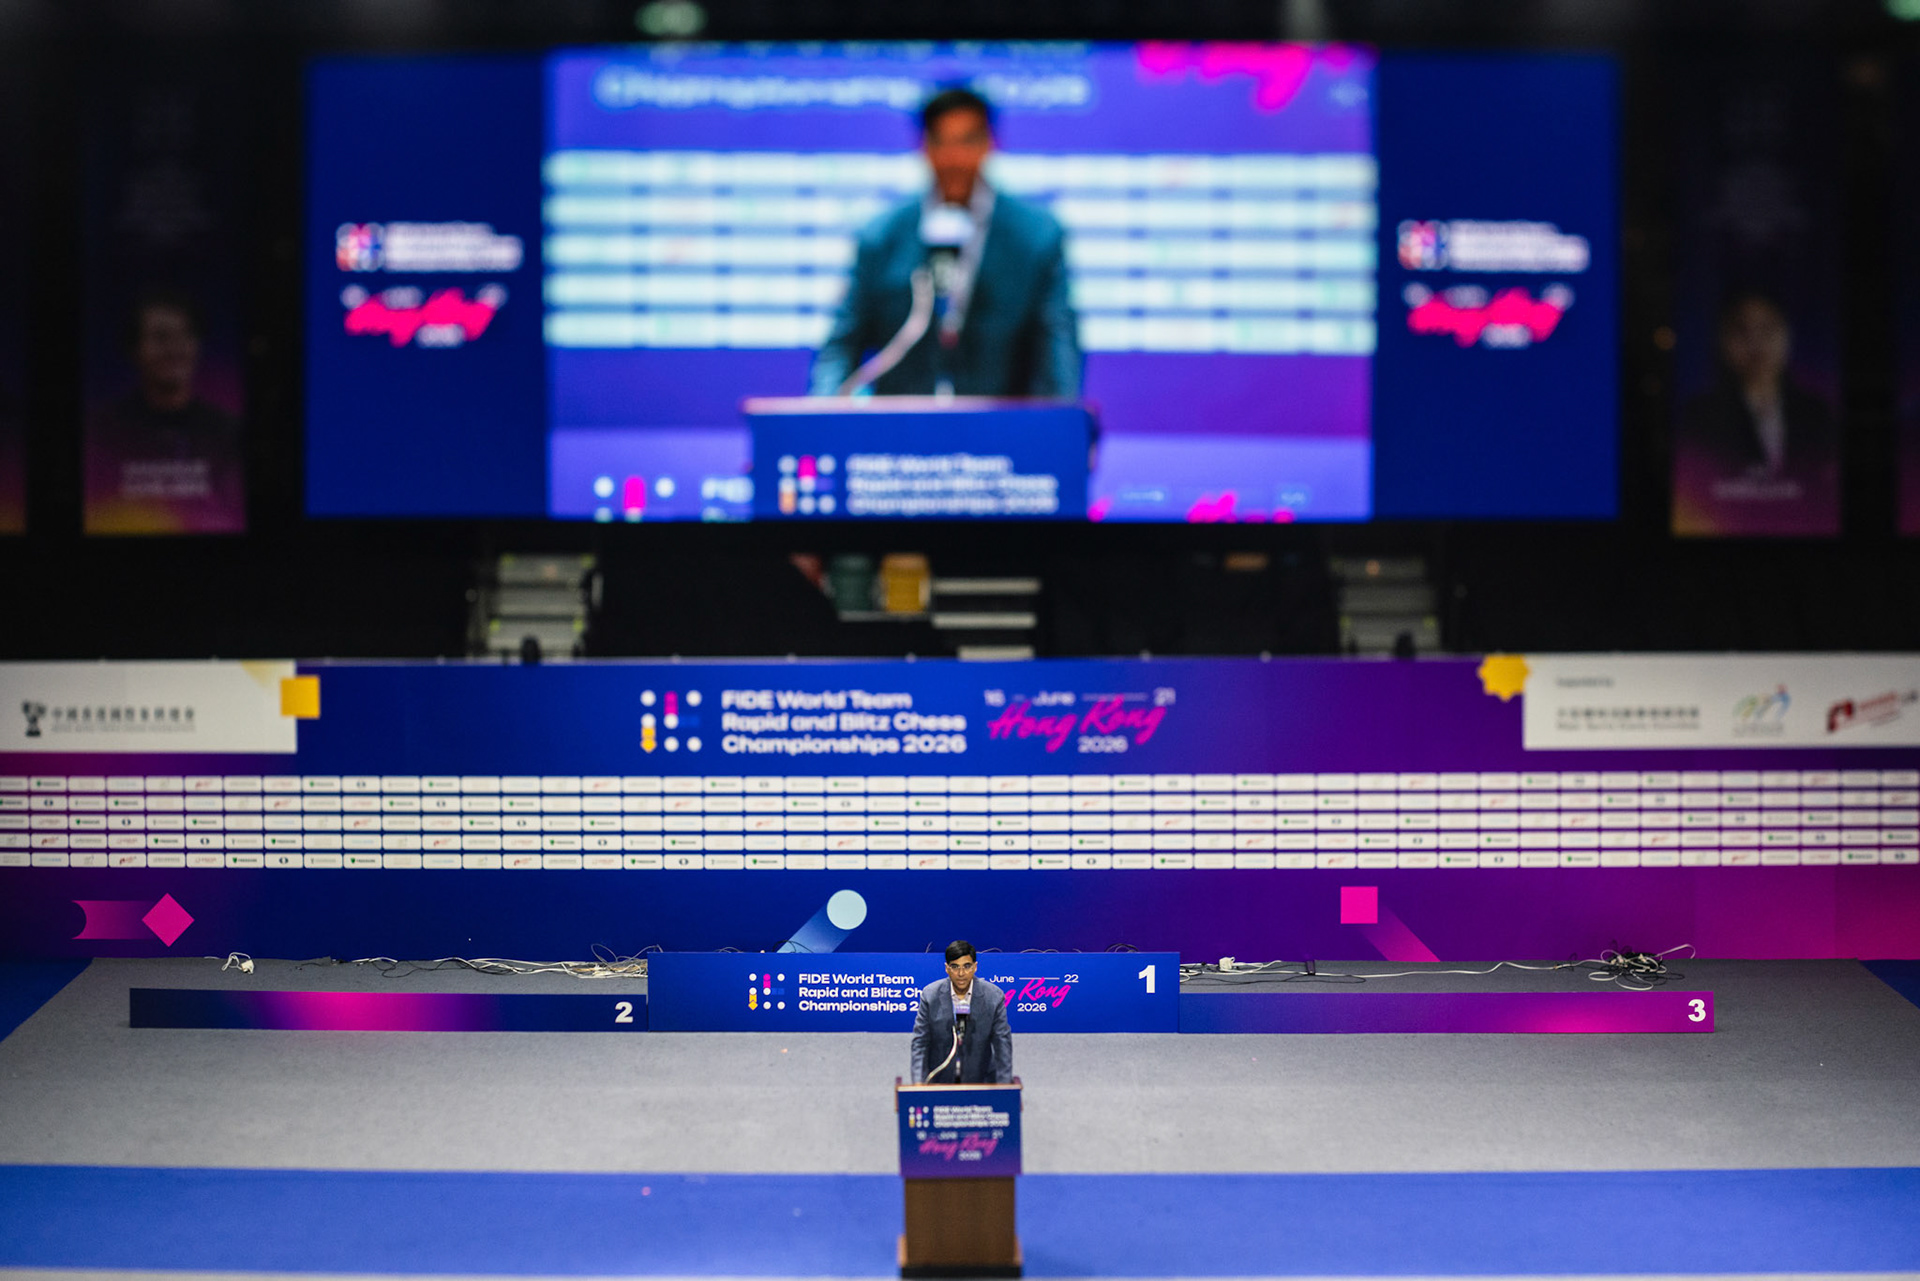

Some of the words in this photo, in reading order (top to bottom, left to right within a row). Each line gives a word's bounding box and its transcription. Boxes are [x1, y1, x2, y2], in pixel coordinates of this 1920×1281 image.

[721, 689, 774, 710] FIDE
[775, 689, 847, 710] World
[847, 689, 913, 710] Team
[1032, 690, 1076, 707] June
[721, 712, 789, 734] Rapid
[790, 713, 838, 732] and
[839, 712, 891, 732] Blitz
[892, 711, 967, 732] Chess
[987, 699, 1078, 753] Hong
[1079, 693, 1168, 746] Kong
[721, 734, 901, 756] Championships
[902, 734, 967, 754] 2026
[1078, 735, 1129, 753] 2026
[799, 973, 830, 984] FIDE
[832, 973, 874, 984] World
[876, 973, 915, 984] Team
[989, 974, 1015, 983] June
[1064, 974, 1079, 983] 22
[1138, 964, 1156, 994] 1
[799, 986, 838, 999] Rapid
[840, 987, 869, 998] and
[871, 986, 902, 998] Blitz
[903, 987, 923, 998] Ch
[1018, 976, 1072, 1008] Kong
[614, 1001, 634, 1023] 2
[798, 1000, 907, 1013] Championships
[909, 1000, 919, 1012] 2
[1017, 1002, 1047, 1012] 2026
[1688, 998, 1707, 1022] 3
